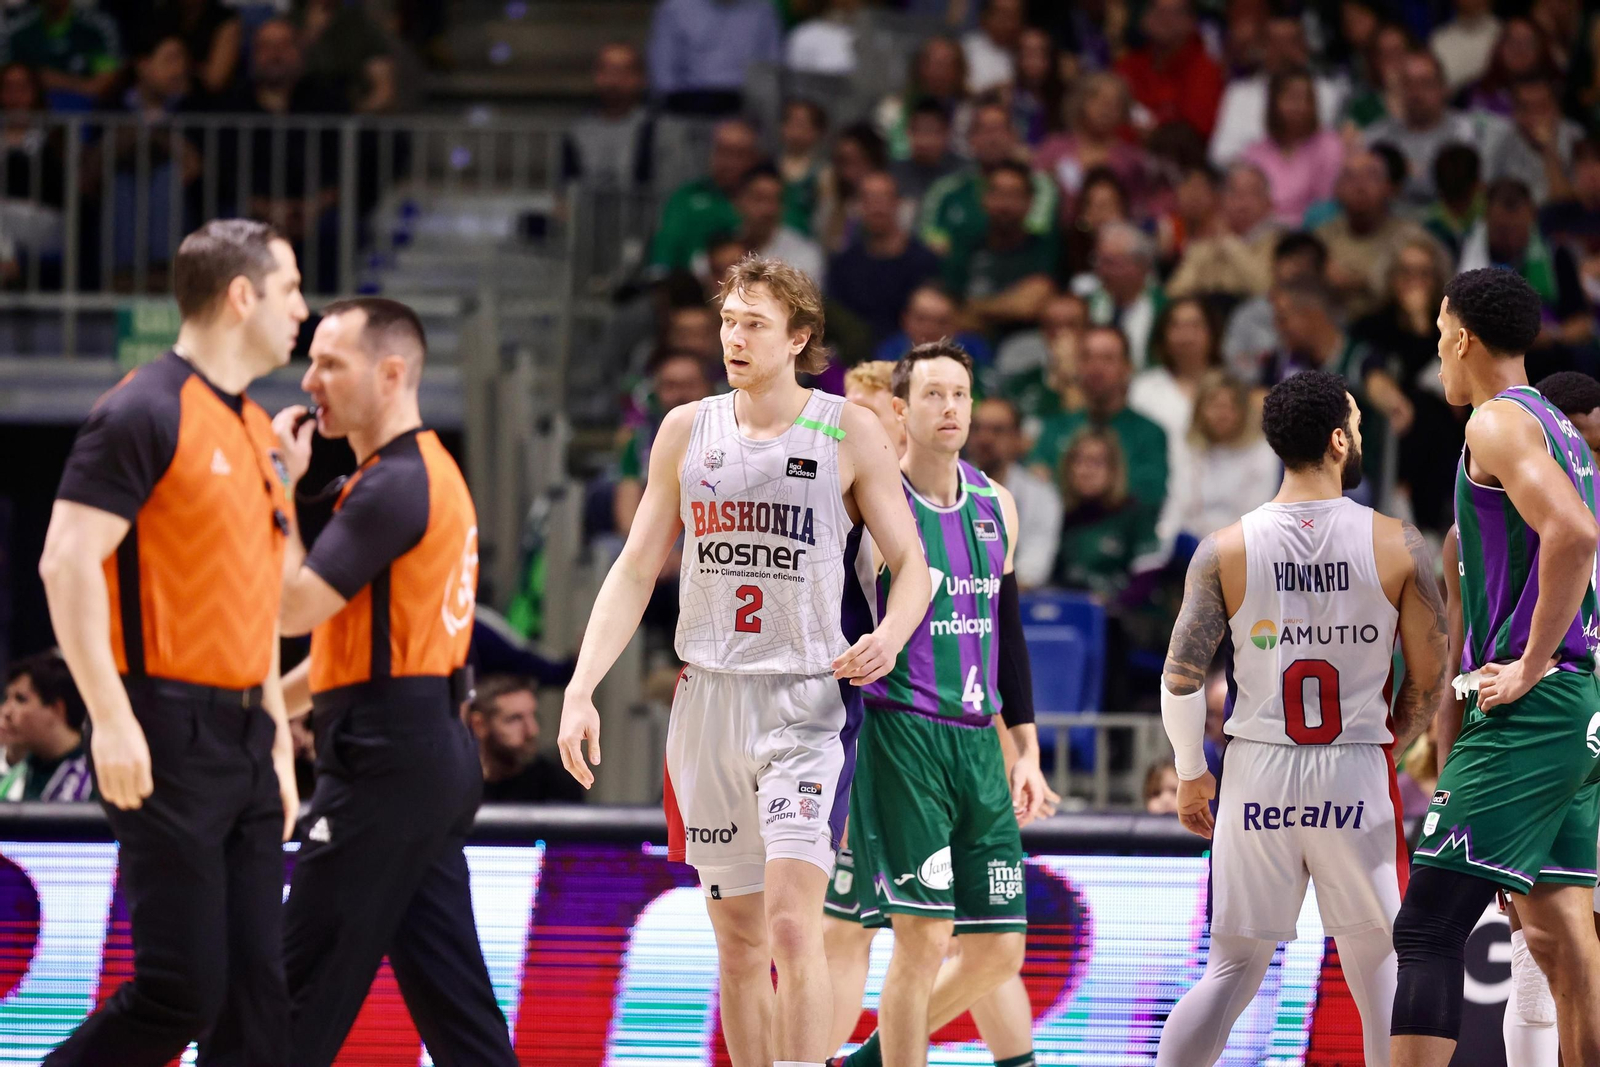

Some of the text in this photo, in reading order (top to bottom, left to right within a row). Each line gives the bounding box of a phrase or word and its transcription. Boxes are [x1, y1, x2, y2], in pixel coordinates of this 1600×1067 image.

[788, 469, 815, 478] endesa
[789, 462, 802, 472] liga
[691, 501, 816, 546] BASKONIA
[721, 568, 805, 583] Climatización eficiente
[946, 573, 1000, 599] Unicaja
[1273, 562, 1349, 592] HOWARD
[735, 584, 763, 633] 2
[1280, 624, 1379, 645] AMUTIO
[962, 665, 985, 711] 4
[1282, 659, 1343, 745] 0
[800, 785, 817, 794] acb
[1243, 801, 1364, 830] Recalvi
[994, 860, 1023, 881] má
[989, 876, 1023, 899] laga
